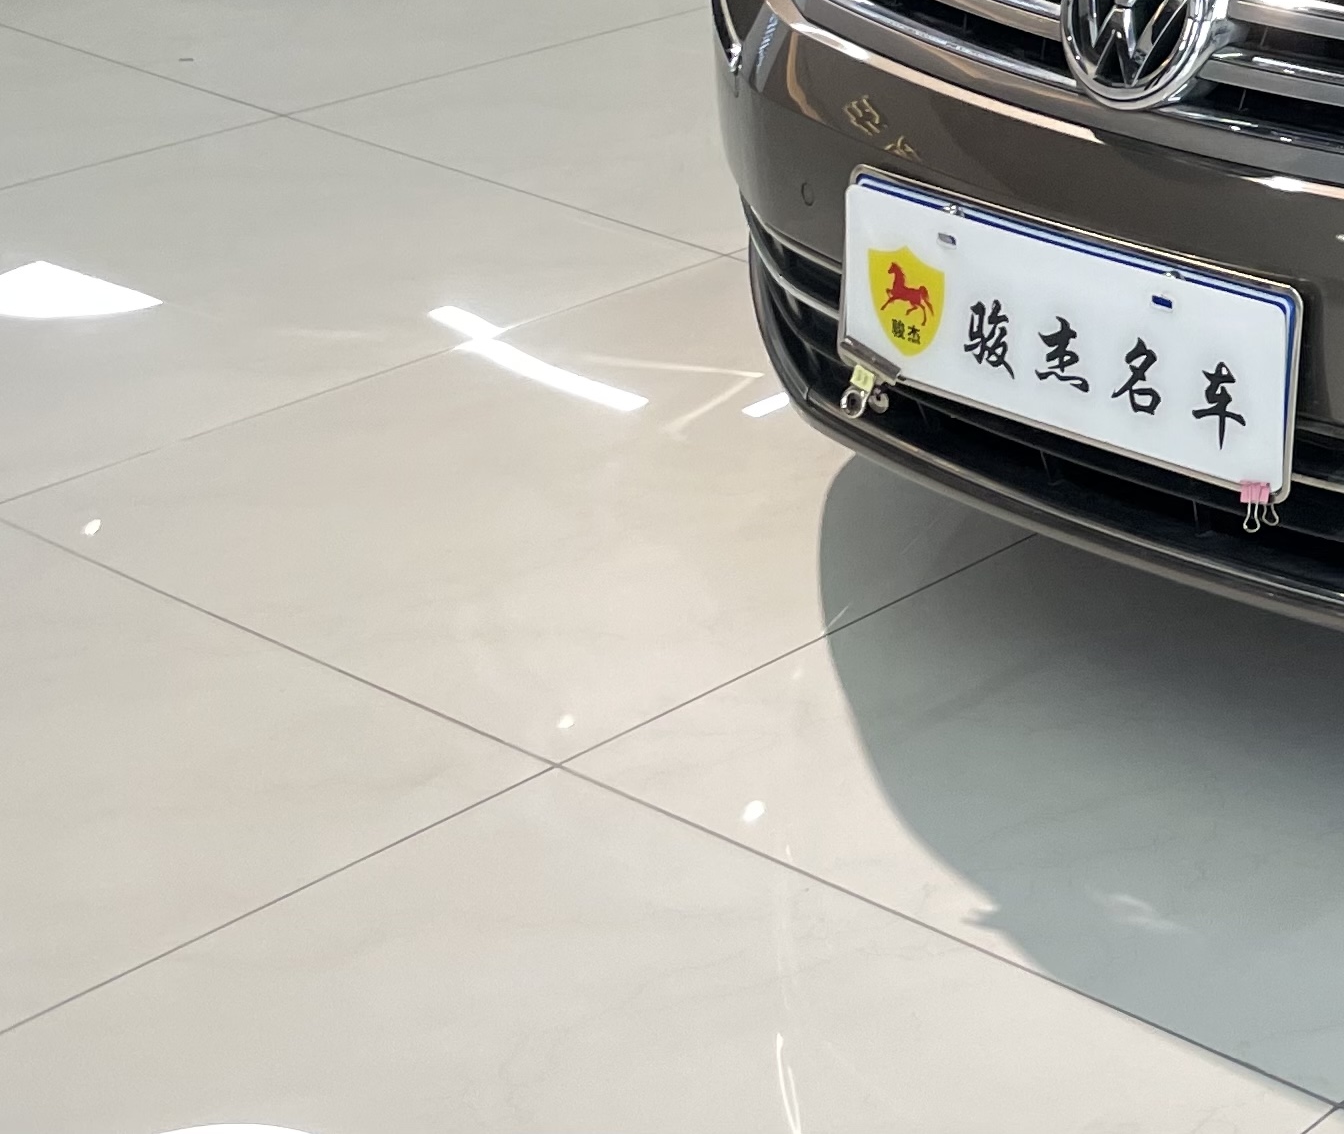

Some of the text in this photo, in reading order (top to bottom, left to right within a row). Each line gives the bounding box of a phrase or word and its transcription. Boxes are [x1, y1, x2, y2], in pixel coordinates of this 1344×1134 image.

[891, 318, 921, 345] 骏杰
[963, 299, 1247, 451] 骏杰名车
